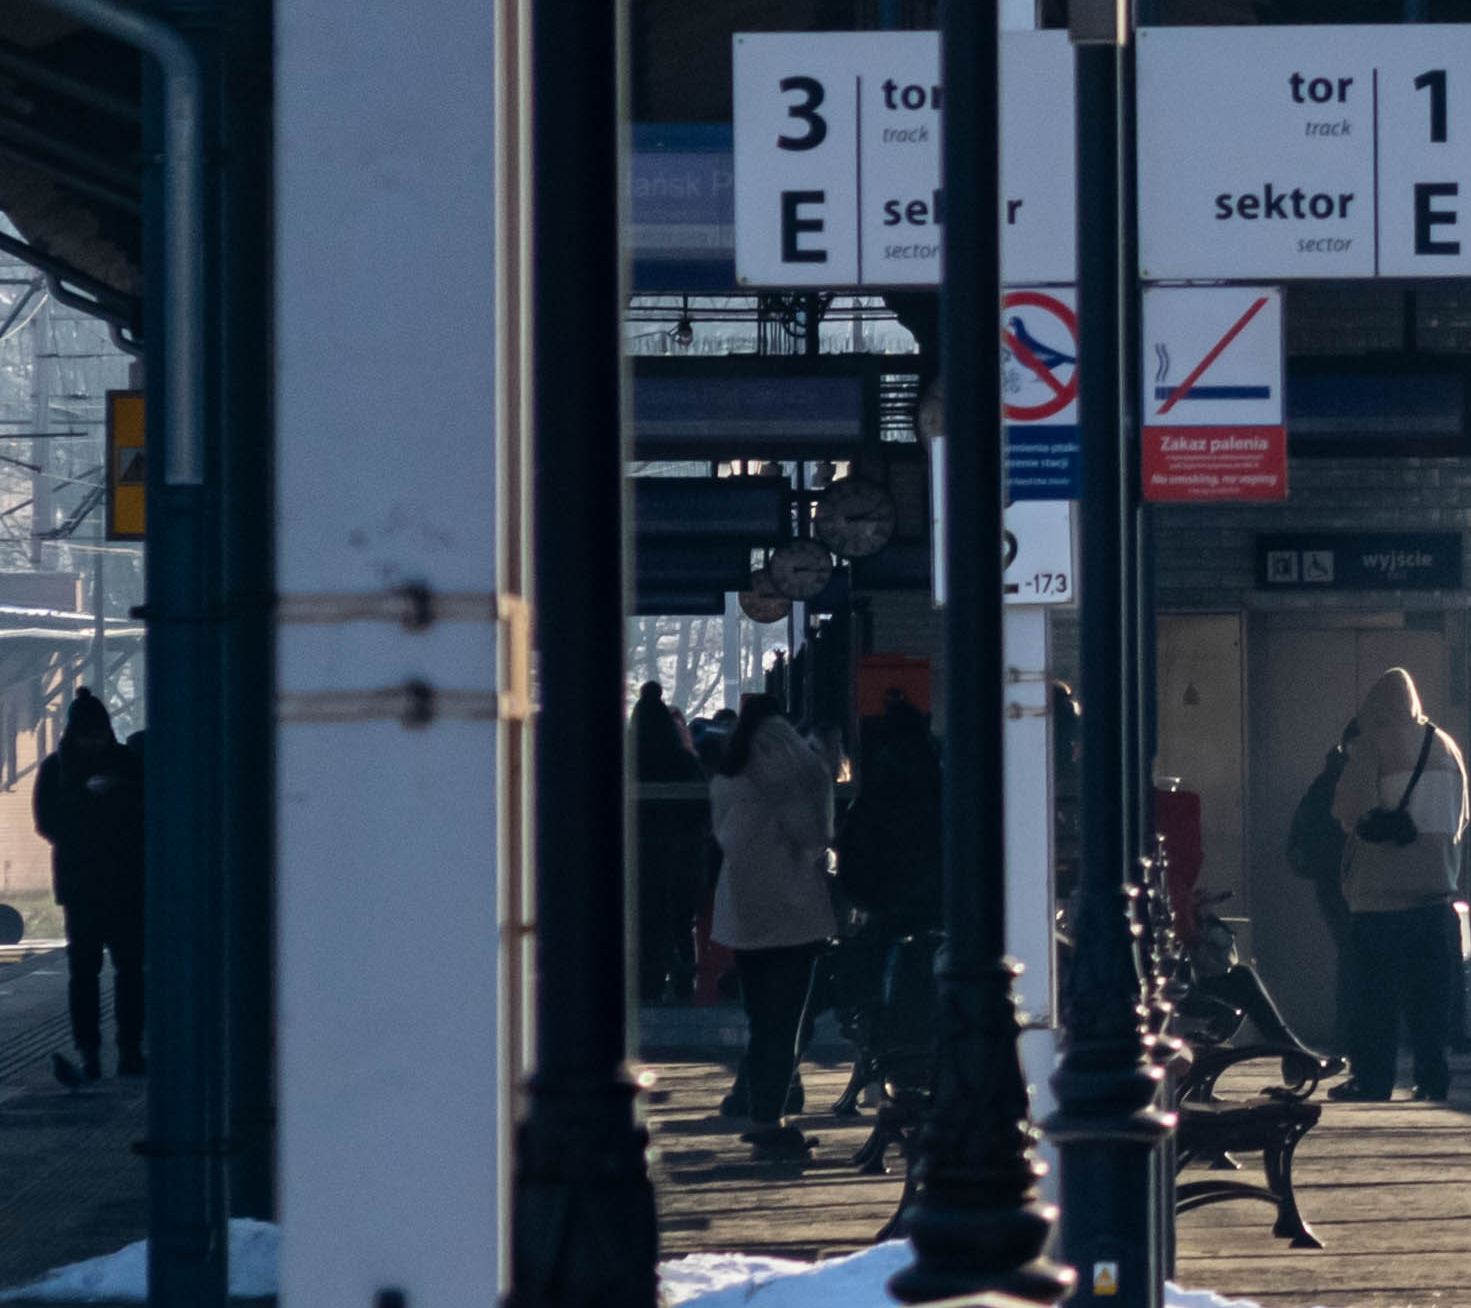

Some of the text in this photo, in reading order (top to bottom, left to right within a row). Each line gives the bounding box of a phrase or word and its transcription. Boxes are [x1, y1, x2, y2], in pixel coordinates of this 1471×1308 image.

[1289, 71, 1353, 104] tor
[776, 75, 828, 152] 3
[1413, 69, 1448, 143] 1
[882, 126, 929, 144] track
[1304, 118, 1352, 137] track
[1214, 183, 1354, 220] sektor
[780, 189, 828, 263] E
[1413, 182, 1461, 255] E
[1297, 236, 1352, 253] sector
[1160, 433, 1269, 453] Zakaz palenia
[1362, 550, 1433, 573] wyjście
[1025, 573, 1068, 595] -17,3
